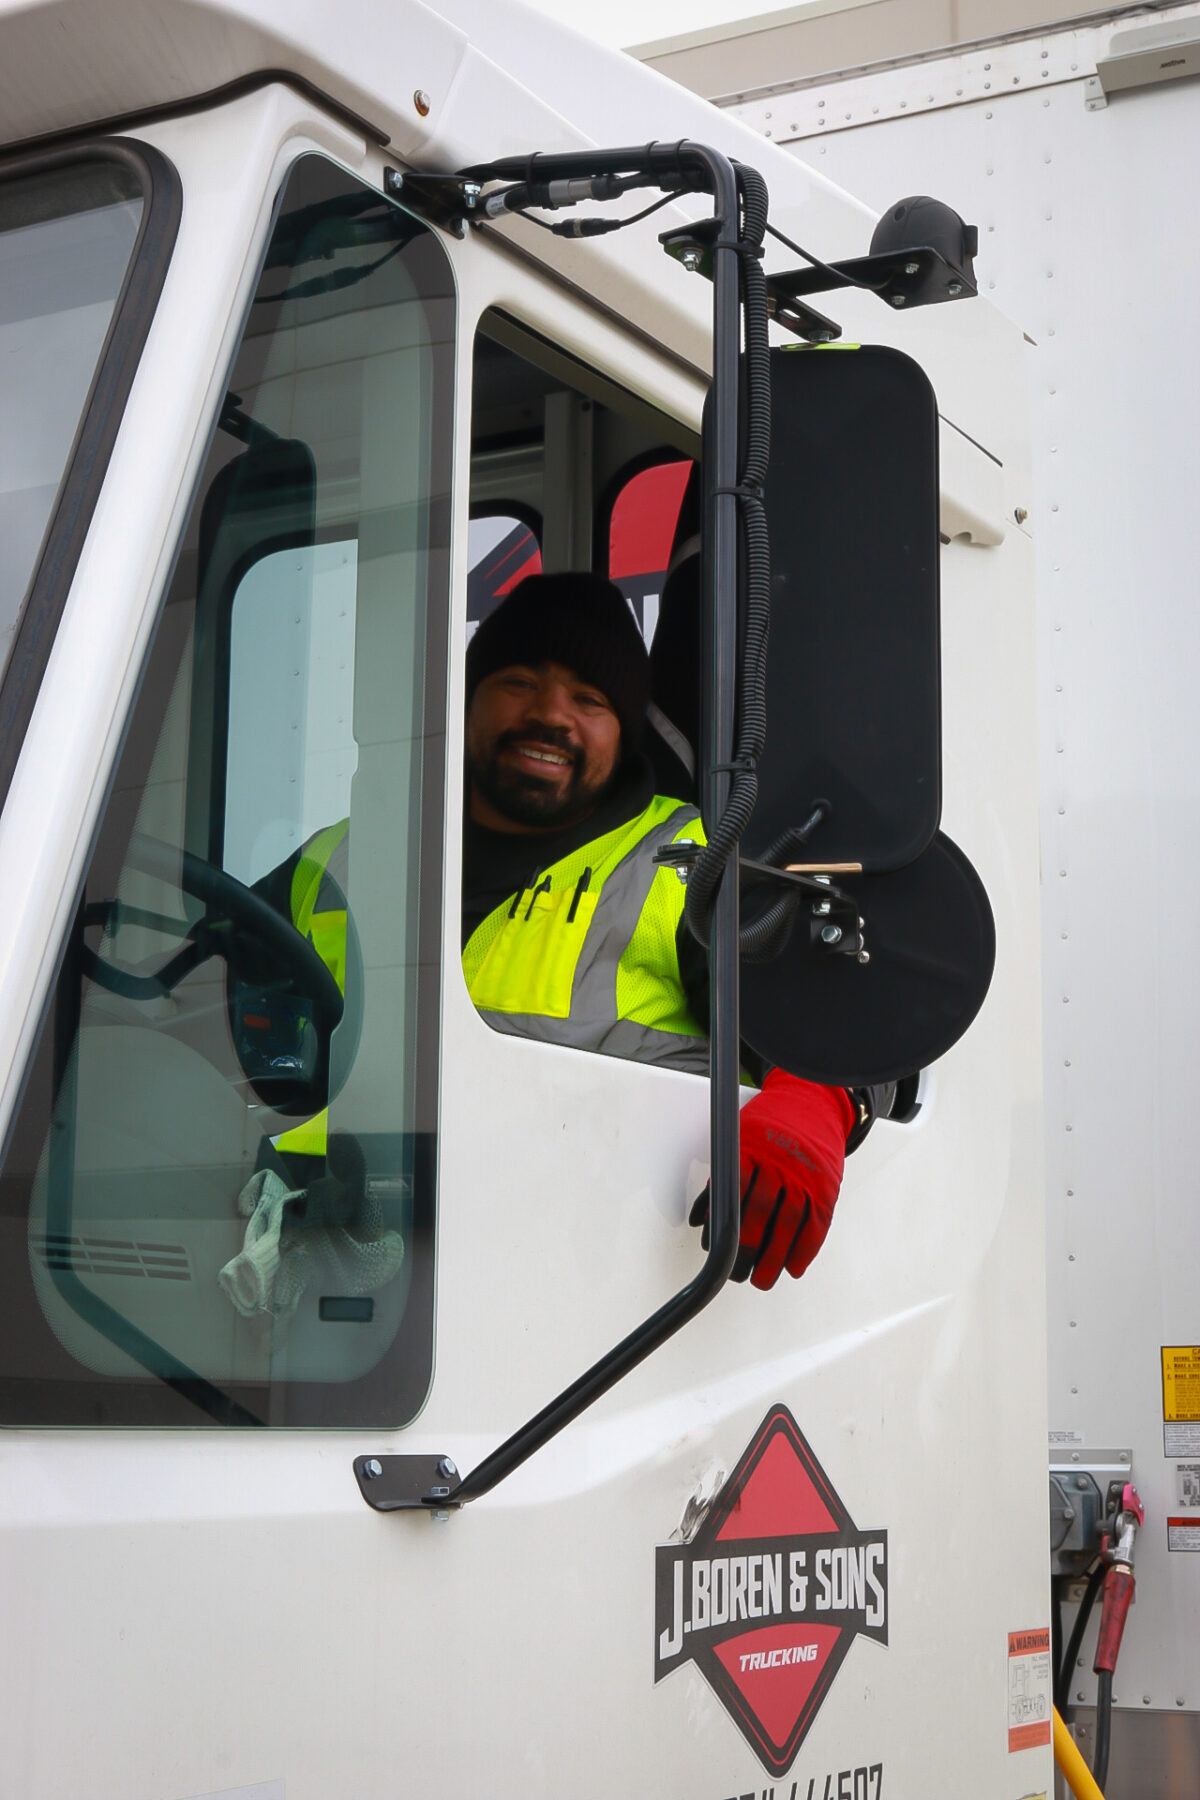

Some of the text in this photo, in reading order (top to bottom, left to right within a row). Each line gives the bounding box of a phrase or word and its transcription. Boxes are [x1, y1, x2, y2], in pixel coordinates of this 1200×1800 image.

[660, 1543, 885, 1660] J.BOREN & SONS
[1016, 1634, 1050, 1650] WARNING
[739, 1644, 818, 1672] TRUCKING
